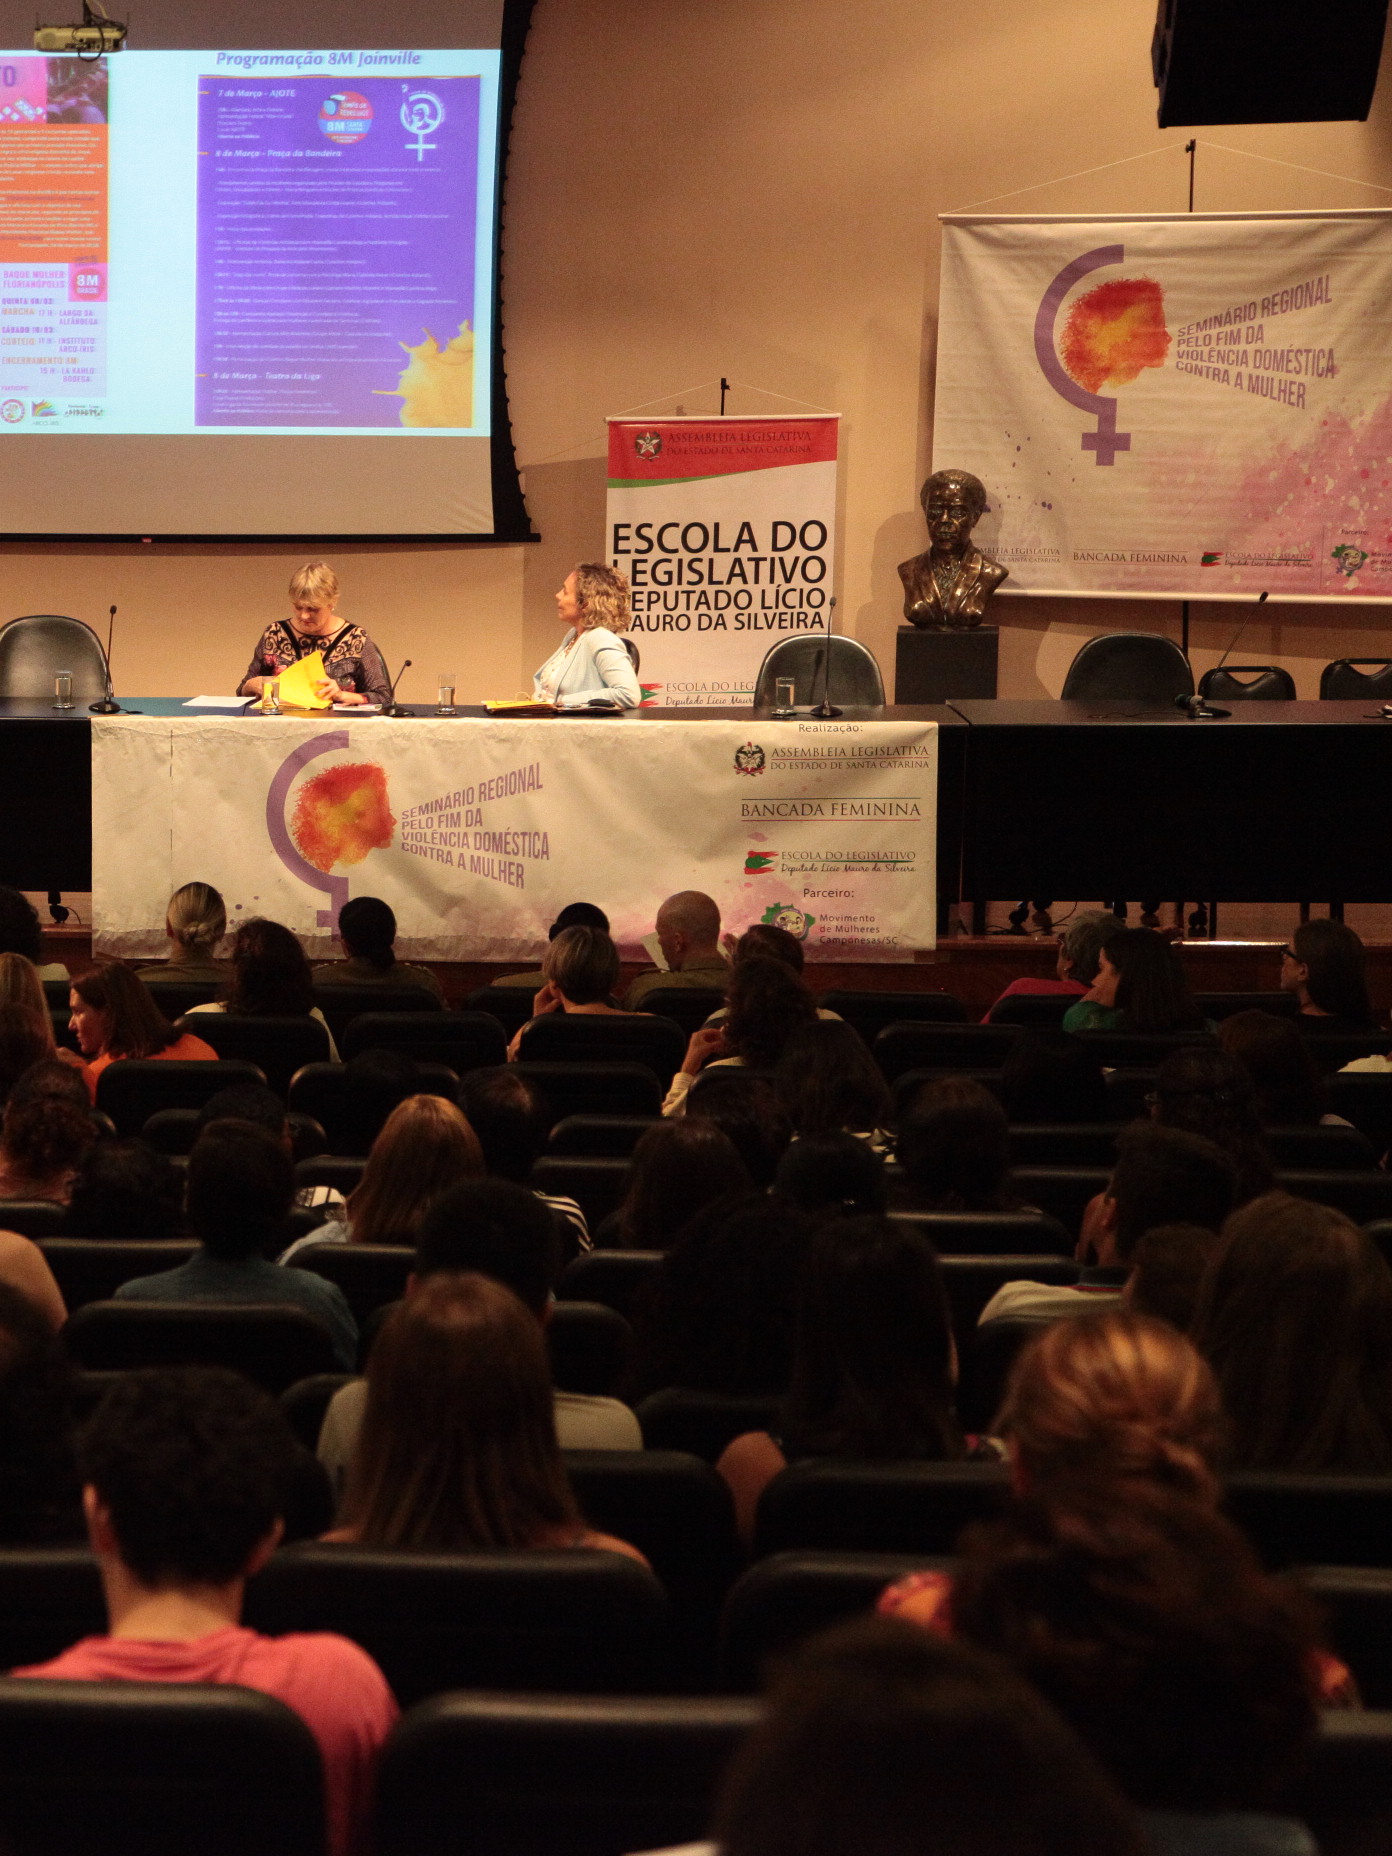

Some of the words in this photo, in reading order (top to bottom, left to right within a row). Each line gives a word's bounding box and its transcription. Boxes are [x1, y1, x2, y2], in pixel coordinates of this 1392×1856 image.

[216, 51, 323, 69] Programação
[328, 52, 353, 65] 8M
[357, 51, 421, 67] Joinville
[236, 90, 263, 99] Março
[327, 121, 346, 132] 8M
[233, 150, 260, 158] Março
[76, 274, 98, 287] 8M
[1177, 301, 1258, 338] SEMINÁRIO
[1261, 274, 1333, 318] REGIONAL
[1177, 333, 1212, 348] PELO
[1216, 328, 1242, 346] FIM
[1245, 324, 1265, 345] DA
[1176, 347, 1249, 368] VIOLÊNCIA
[1253, 344, 1335, 379] DOMÉSTICA
[1175, 360, 1231, 386] CONTRA
[1234, 371, 1244, 390] A
[1247, 373, 1306, 410] MULHER
[668, 432, 737, 443] ASSEMBLEIA
[740, 431, 812, 442] LEGISLATIVA
[766, 445, 812, 454] CATARINA
[612, 521, 759, 555] ESCOLA
[771, 519, 828, 553] DO
[1011, 547, 1060, 555] LEGISLATIVA
[1073, 552, 1126, 561] BANCADA
[1130, 553, 1188, 563] FEMININA
[630, 589, 753, 612] EPUTADO
[760, 584, 826, 610] LÍCIO
[697, 613, 728, 632] DA
[734, 611, 825, 631] SILVEIRA
[666, 682, 707, 693] ESCOLA
[711, 681, 730, 692] DO
[665, 696, 704, 707] Deputado
[730, 695, 754, 705] Maur
[798, 723, 864, 734] Realização:
[771, 747, 847, 757] ASSEMBLEIA
[851, 745, 929, 757] LEGISLATIVA
[770, 761, 786, 770] DO
[789, 761, 827, 770] ESTADO
[830, 761, 843, 769] DE
[846, 761, 877, 769] SANTA
[879, 760, 929, 769] CATARINA
[401, 786, 475, 820] SEMINÁRIO
[478, 762, 543, 803] REGIONAL
[741, 803, 825, 817] BANCADA
[831, 802, 921, 816] FEMININA
[401, 817, 434, 830] PELO
[438, 811, 461, 829] FIM
[465, 808, 483, 827] DA
[401, 829, 470, 849] VIOLÊNCIA
[474, 827, 550, 860] DOMÉSTICA
[781, 851, 822, 860] ESCOLA
[825, 851, 843, 860] DO
[846, 851, 916, 860] LEGISLATIVO
[401, 842, 454, 866] CONTRA
[457, 853, 466, 870] A
[470, 854, 525, 889] MULHER
[781, 863, 818, 876] Deputado
[844, 863, 869, 873] Mauro
[871, 863, 882, 872] da
[885, 863, 916, 873] Silveira
[803, 888, 855, 898] Parceiro:
[819, 914, 875, 923] Movimento
[835, 925, 880, 933] Mulheres
[819, 936, 898, 945] Camponesas/SC
